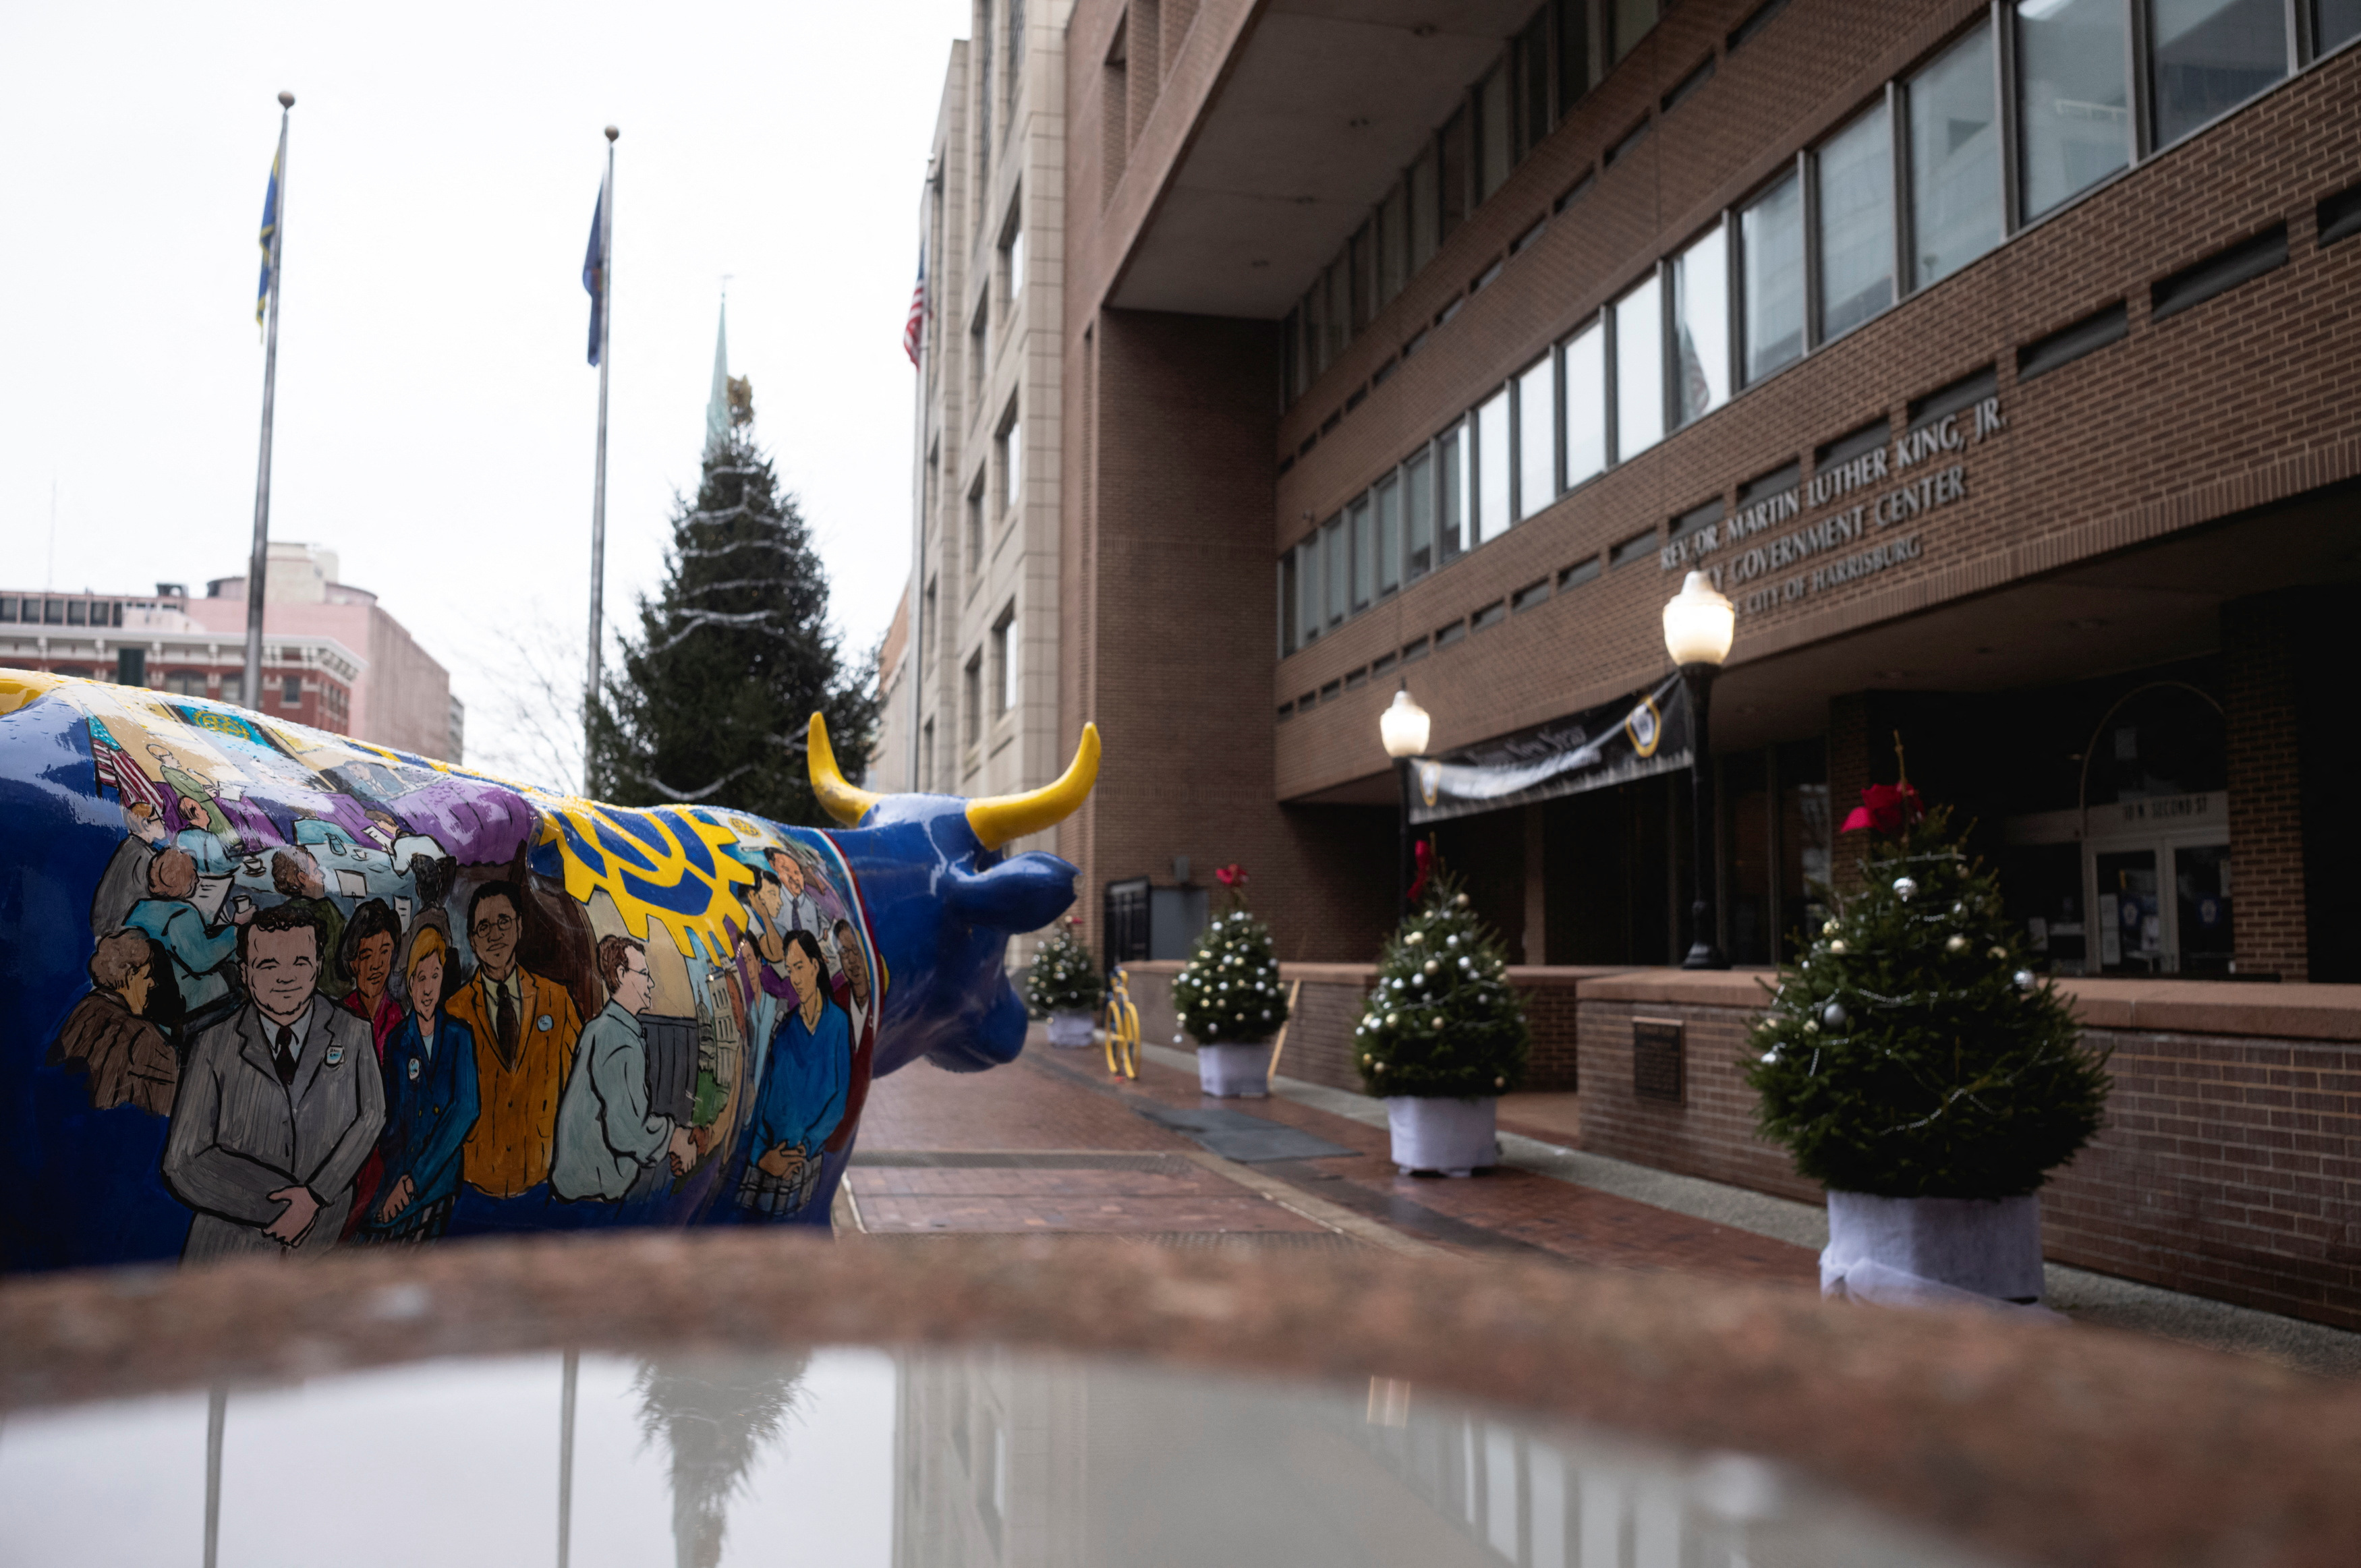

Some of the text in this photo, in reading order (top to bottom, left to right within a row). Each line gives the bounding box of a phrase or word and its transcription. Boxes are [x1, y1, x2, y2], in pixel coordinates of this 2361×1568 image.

[1727, 486, 1800, 543] MARTIN
[1807, 446, 1889, 506] LUTHER
[1896, 414, 1965, 468] KING,
[1974, 397, 2008, 443] JR.
[1731, 505, 1865, 584] GOVERNMENT
[1875, 465, 1966, 527] CENTER
[1747, 587, 1779, 614] CITY
[1785, 575, 1804, 601] OF
[1813, 533, 1921, 592] HARRISBURG
[2152, 798, 2192, 819] SECOND
